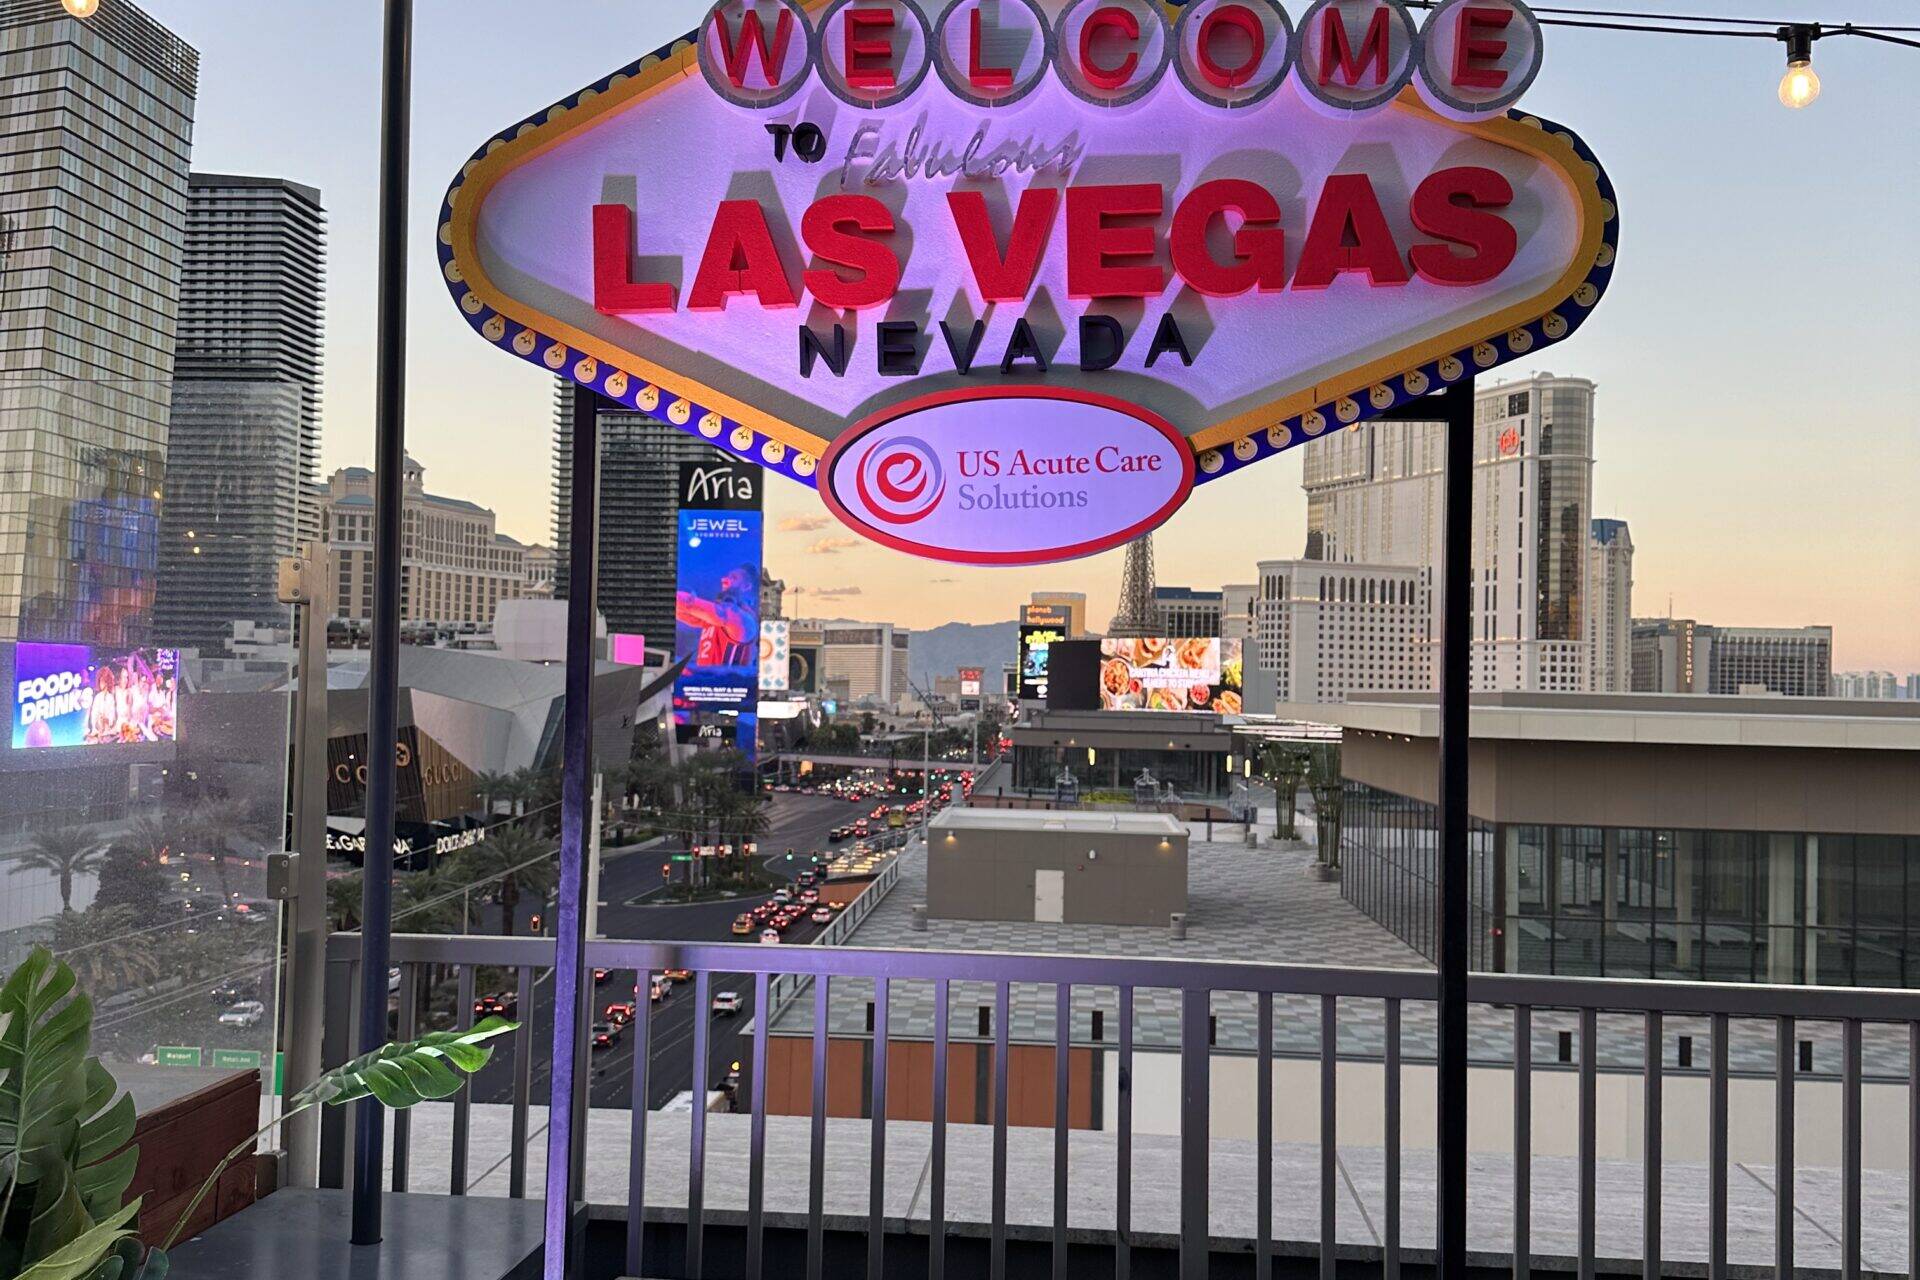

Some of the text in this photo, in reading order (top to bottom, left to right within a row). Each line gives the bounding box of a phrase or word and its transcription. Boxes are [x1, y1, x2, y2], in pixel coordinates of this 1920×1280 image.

[714, 5, 1514, 90] WELCOME
[764, 120, 1085, 189] TO Fabulous
[593, 166, 1517, 313] LAS VEGAS
[799, 313, 1194, 378] NEVADA
[957, 446, 1162, 477] US Acute Care
[687, 467, 753, 502] Aria
[958, 484, 1088, 511] Solutions
[687, 519, 748, 531] JEWEL
[20, 687, 94, 726] DRINKS
[425, 762, 463, 786] GUCCI
